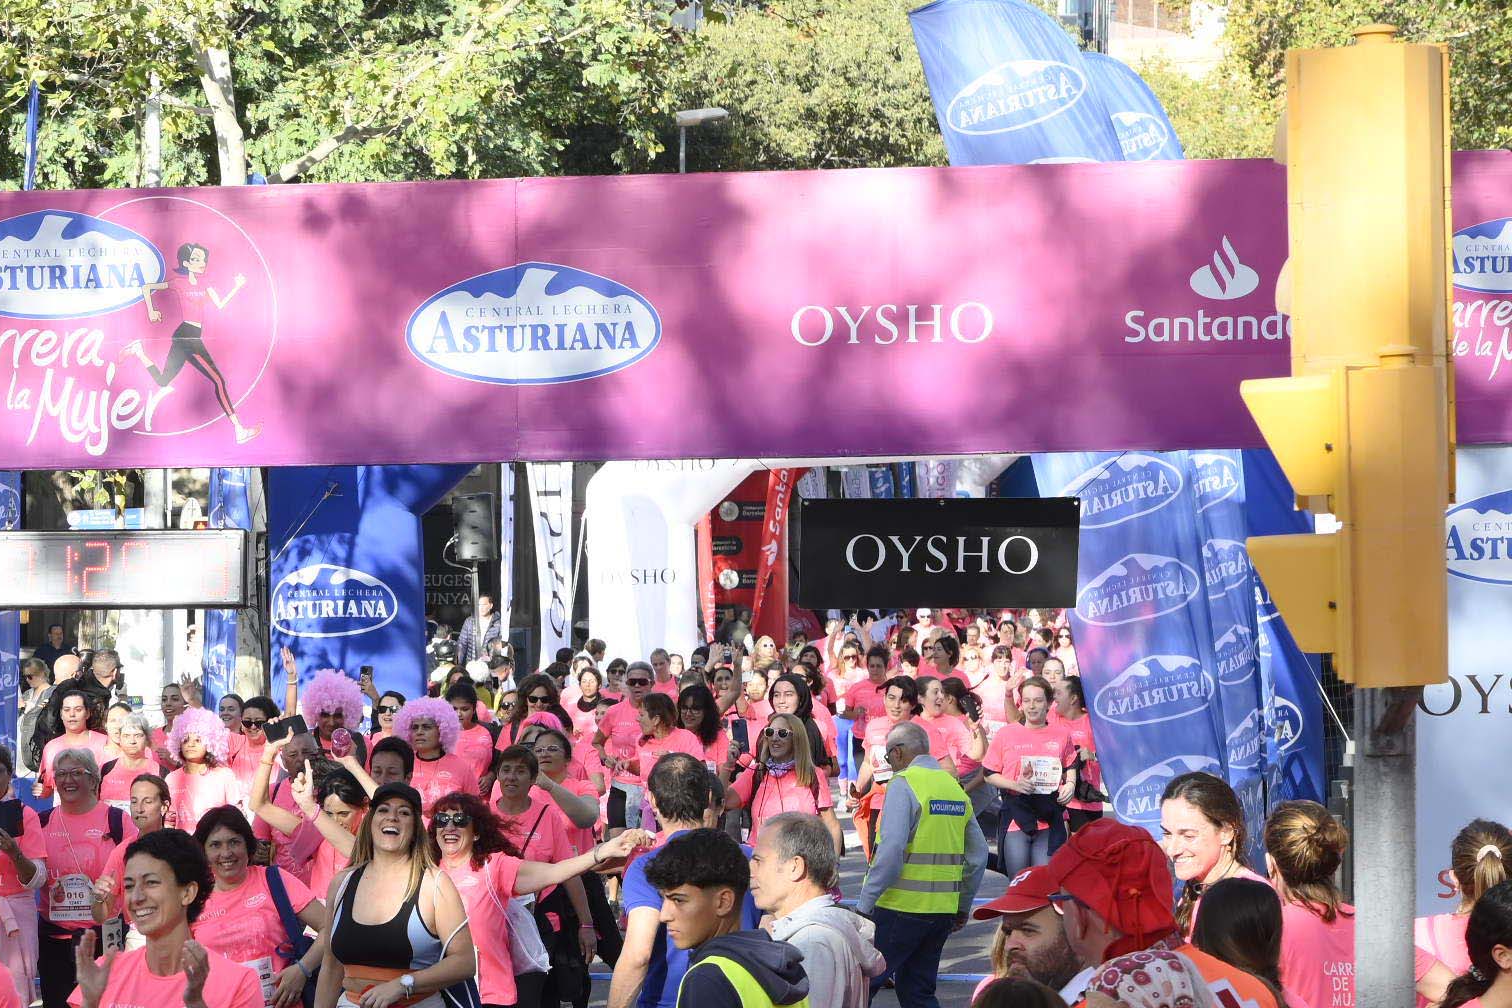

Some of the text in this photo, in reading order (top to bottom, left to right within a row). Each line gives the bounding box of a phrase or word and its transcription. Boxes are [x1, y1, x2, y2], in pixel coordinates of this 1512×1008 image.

[465, 303, 632, 318] CENTRAL LECHERA
[791, 302, 993, 346] OYSHO
[1453, 300, 1512, 327] arre
[427, 310, 642, 354] ASTURIANA
[1476, 328, 1493, 357] la
[6, 370, 31, 410] la
[25, 362, 175, 456] Mujer
[846, 534, 1039, 574] OYSHO
[288, 588, 383, 597] CENTRAL LECHERA
[275, 594, 388, 621] ASTURIANA
[67, 891, 84, 899] 016
[1323, 960, 1354, 976] CARR
[1332, 976, 1349, 991] DE
